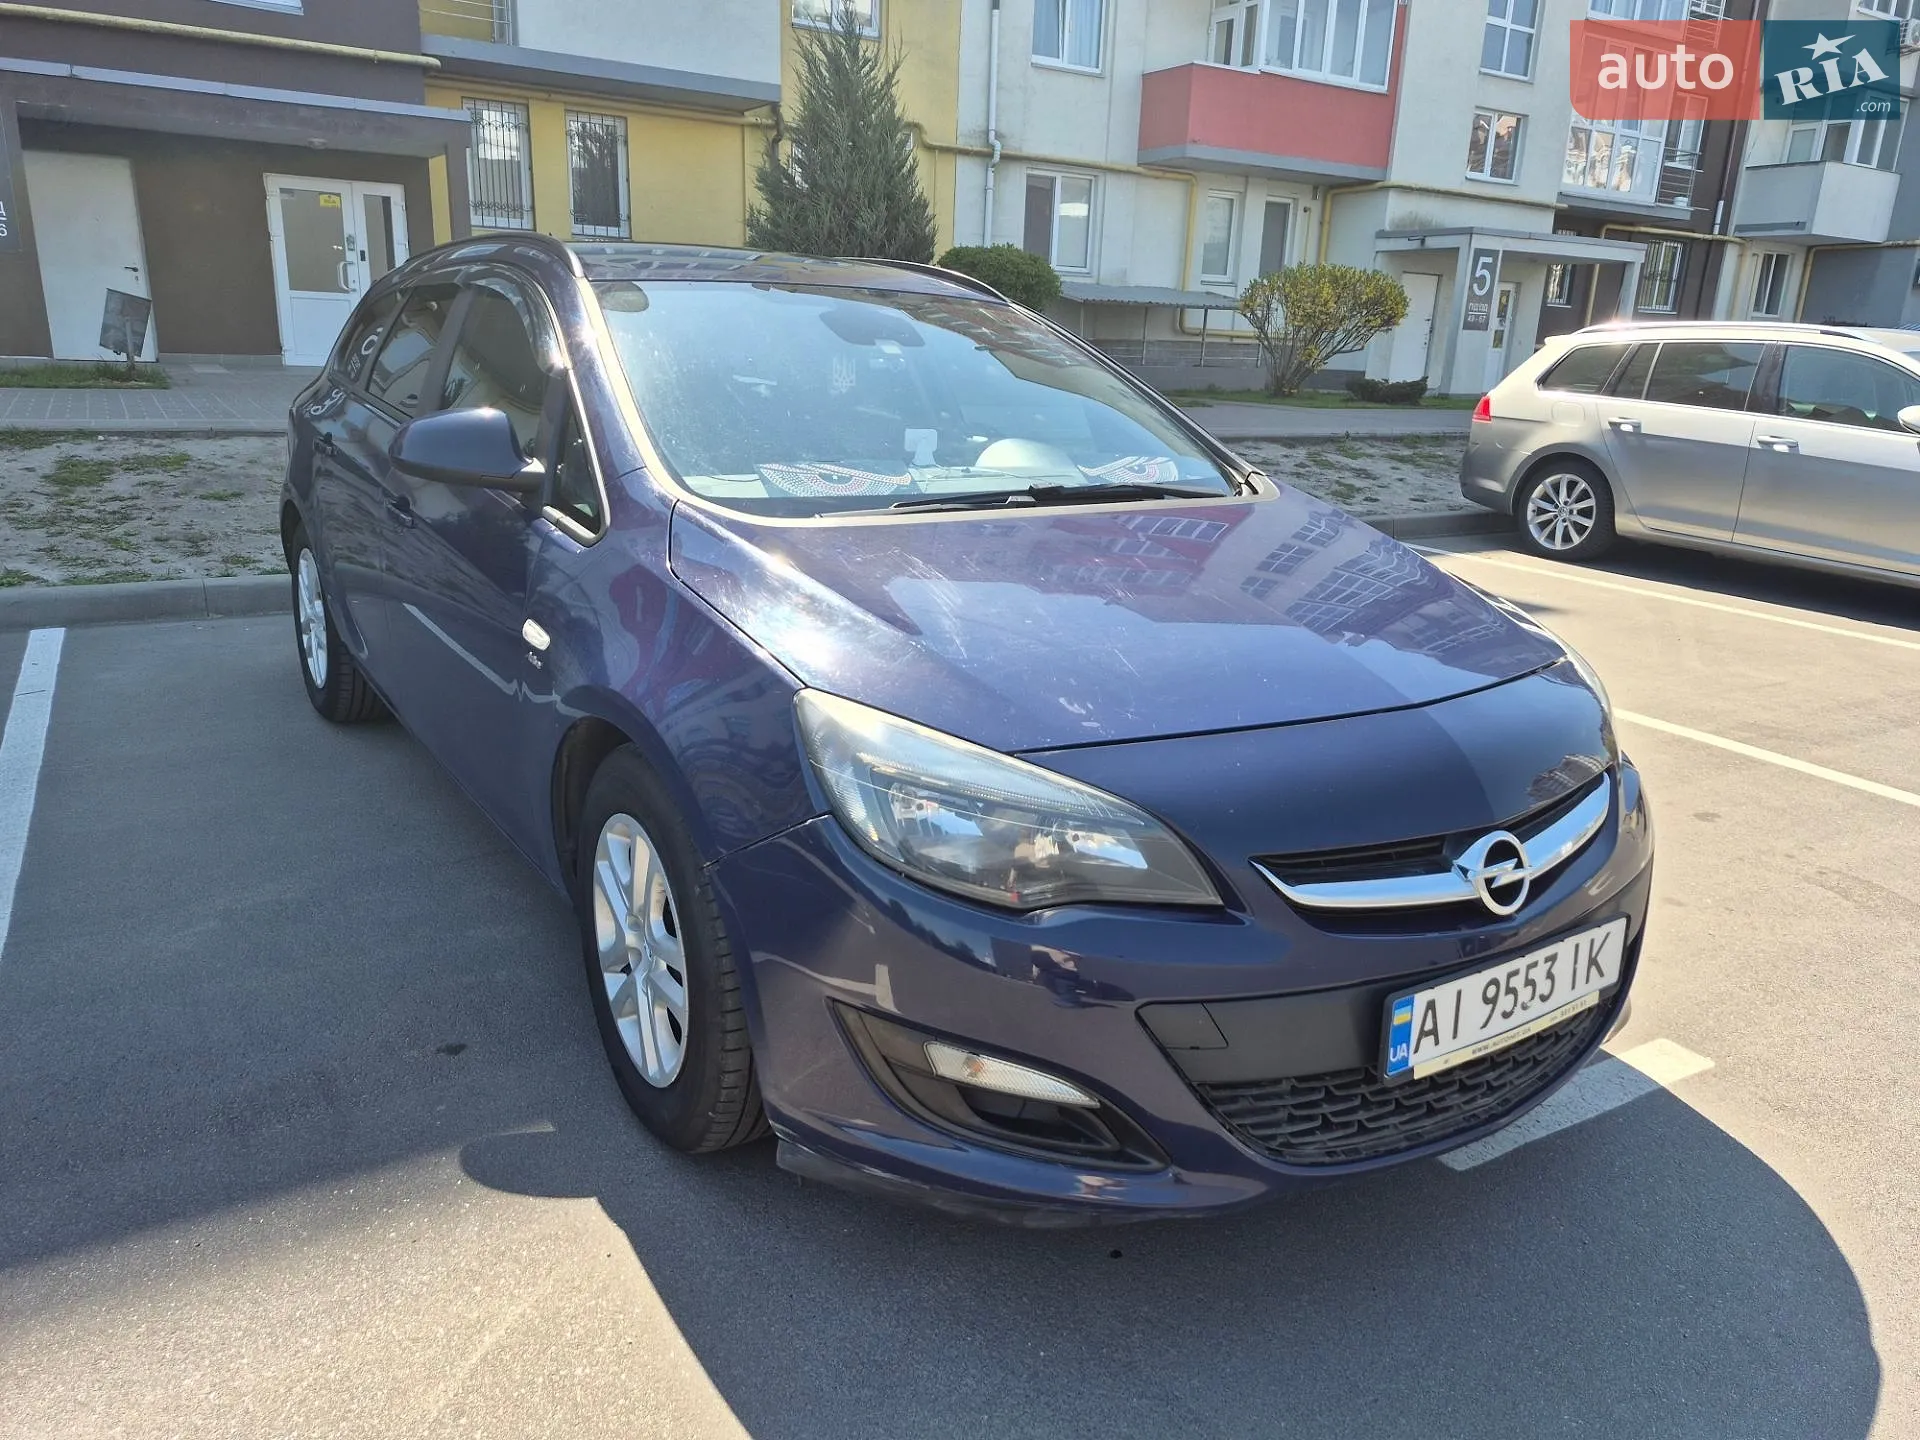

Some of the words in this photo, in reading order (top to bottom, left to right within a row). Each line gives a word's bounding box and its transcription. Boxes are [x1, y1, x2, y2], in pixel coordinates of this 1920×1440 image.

[1472, 256, 1493, 296] 5
[1413, 989, 1462, 1054] AI
[1480, 952, 1559, 1029] 9553
[1571, 931, 1611, 990] IK
[1389, 1042, 1408, 1062] UA
